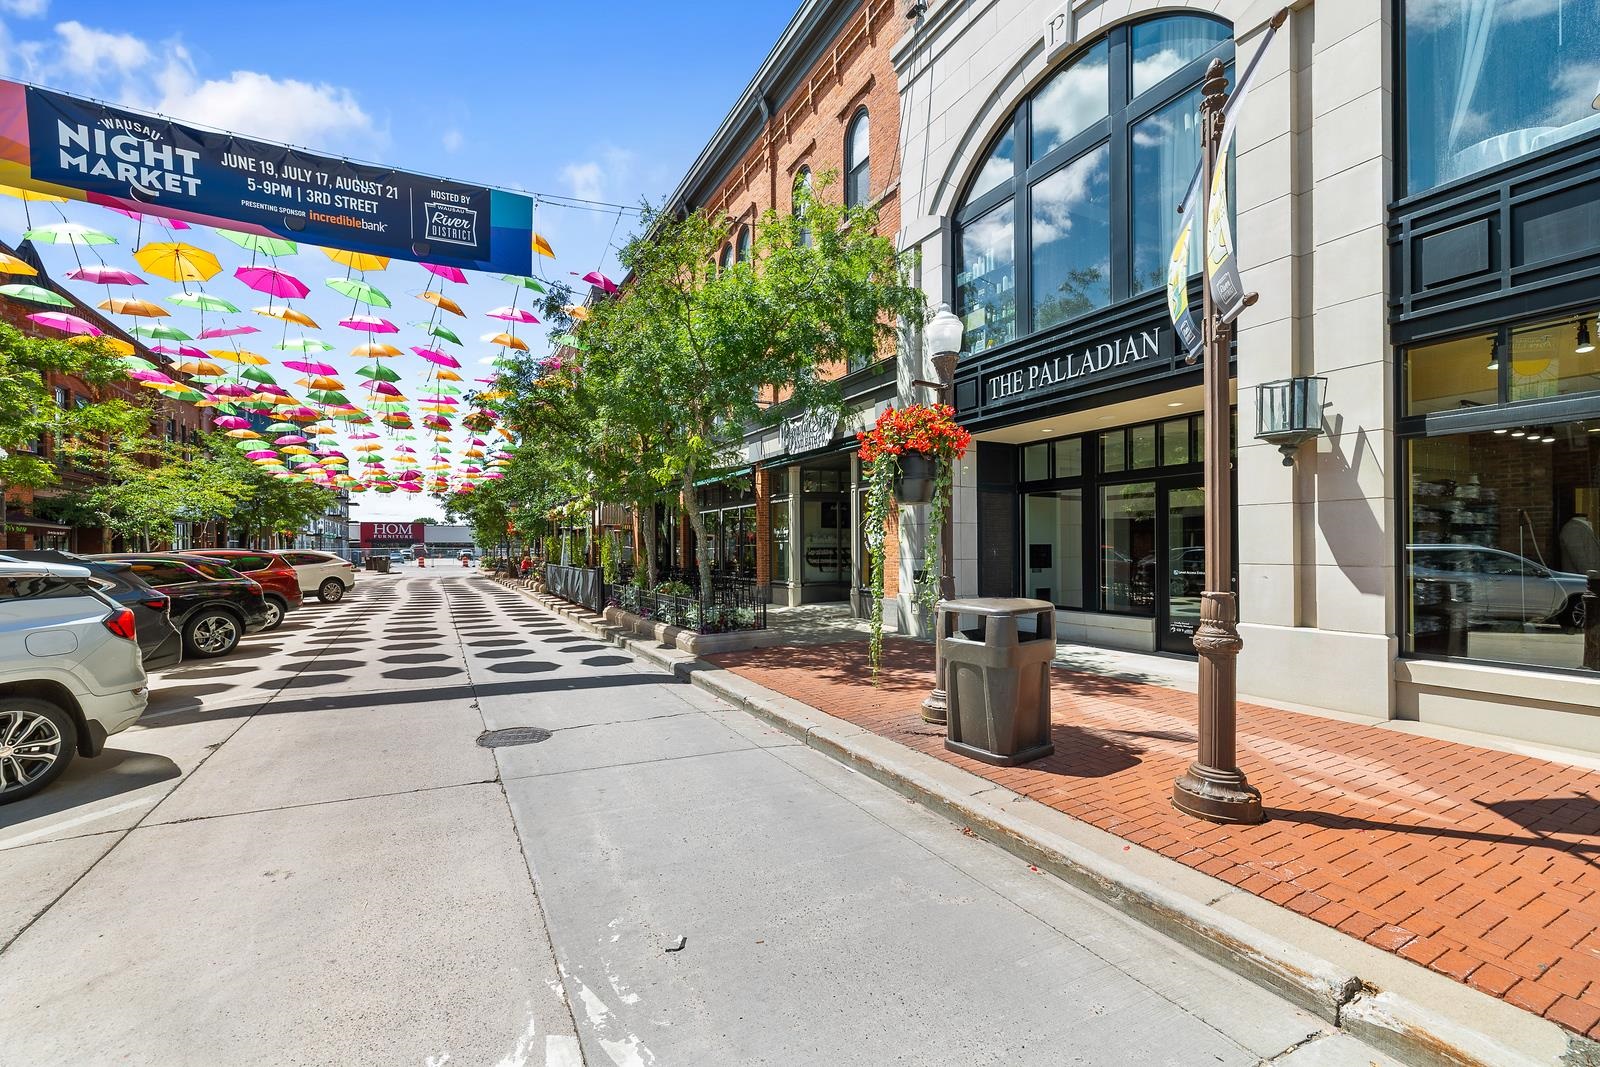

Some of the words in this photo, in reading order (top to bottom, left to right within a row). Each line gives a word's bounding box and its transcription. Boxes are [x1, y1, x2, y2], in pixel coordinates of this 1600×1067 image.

[101, 118, 160, 141] WAUSAU
[57, 119, 200, 175] NIGHT
[59, 148, 201, 197] MARKET
[221, 152, 257, 172] JUNE
[259, 160, 279, 179] 19,
[282, 166, 313, 183] JULY
[315, 171, 333, 189] 17,
[335, 176, 383, 197] AUGUST
[386, 187, 399, 200] 21
[247, 178, 293, 198] 5-9PM
[306, 189, 332, 206] 3RD
[334, 195, 379, 214] STREET
[430, 189, 459, 203] HOSTED
[460, 195, 471, 205] BY
[241, 199, 278, 213] PRESENTING
[278, 206, 306, 218] SPONSOR
[437, 205, 465, 214] WAUSAU
[431, 211, 471, 229] River
[432, 225, 471, 241] DISTRICT
[989, 369, 1025, 400] THE
[1027, 326, 1161, 390] PALLADIAN
[373, 523, 413, 535] HOM
